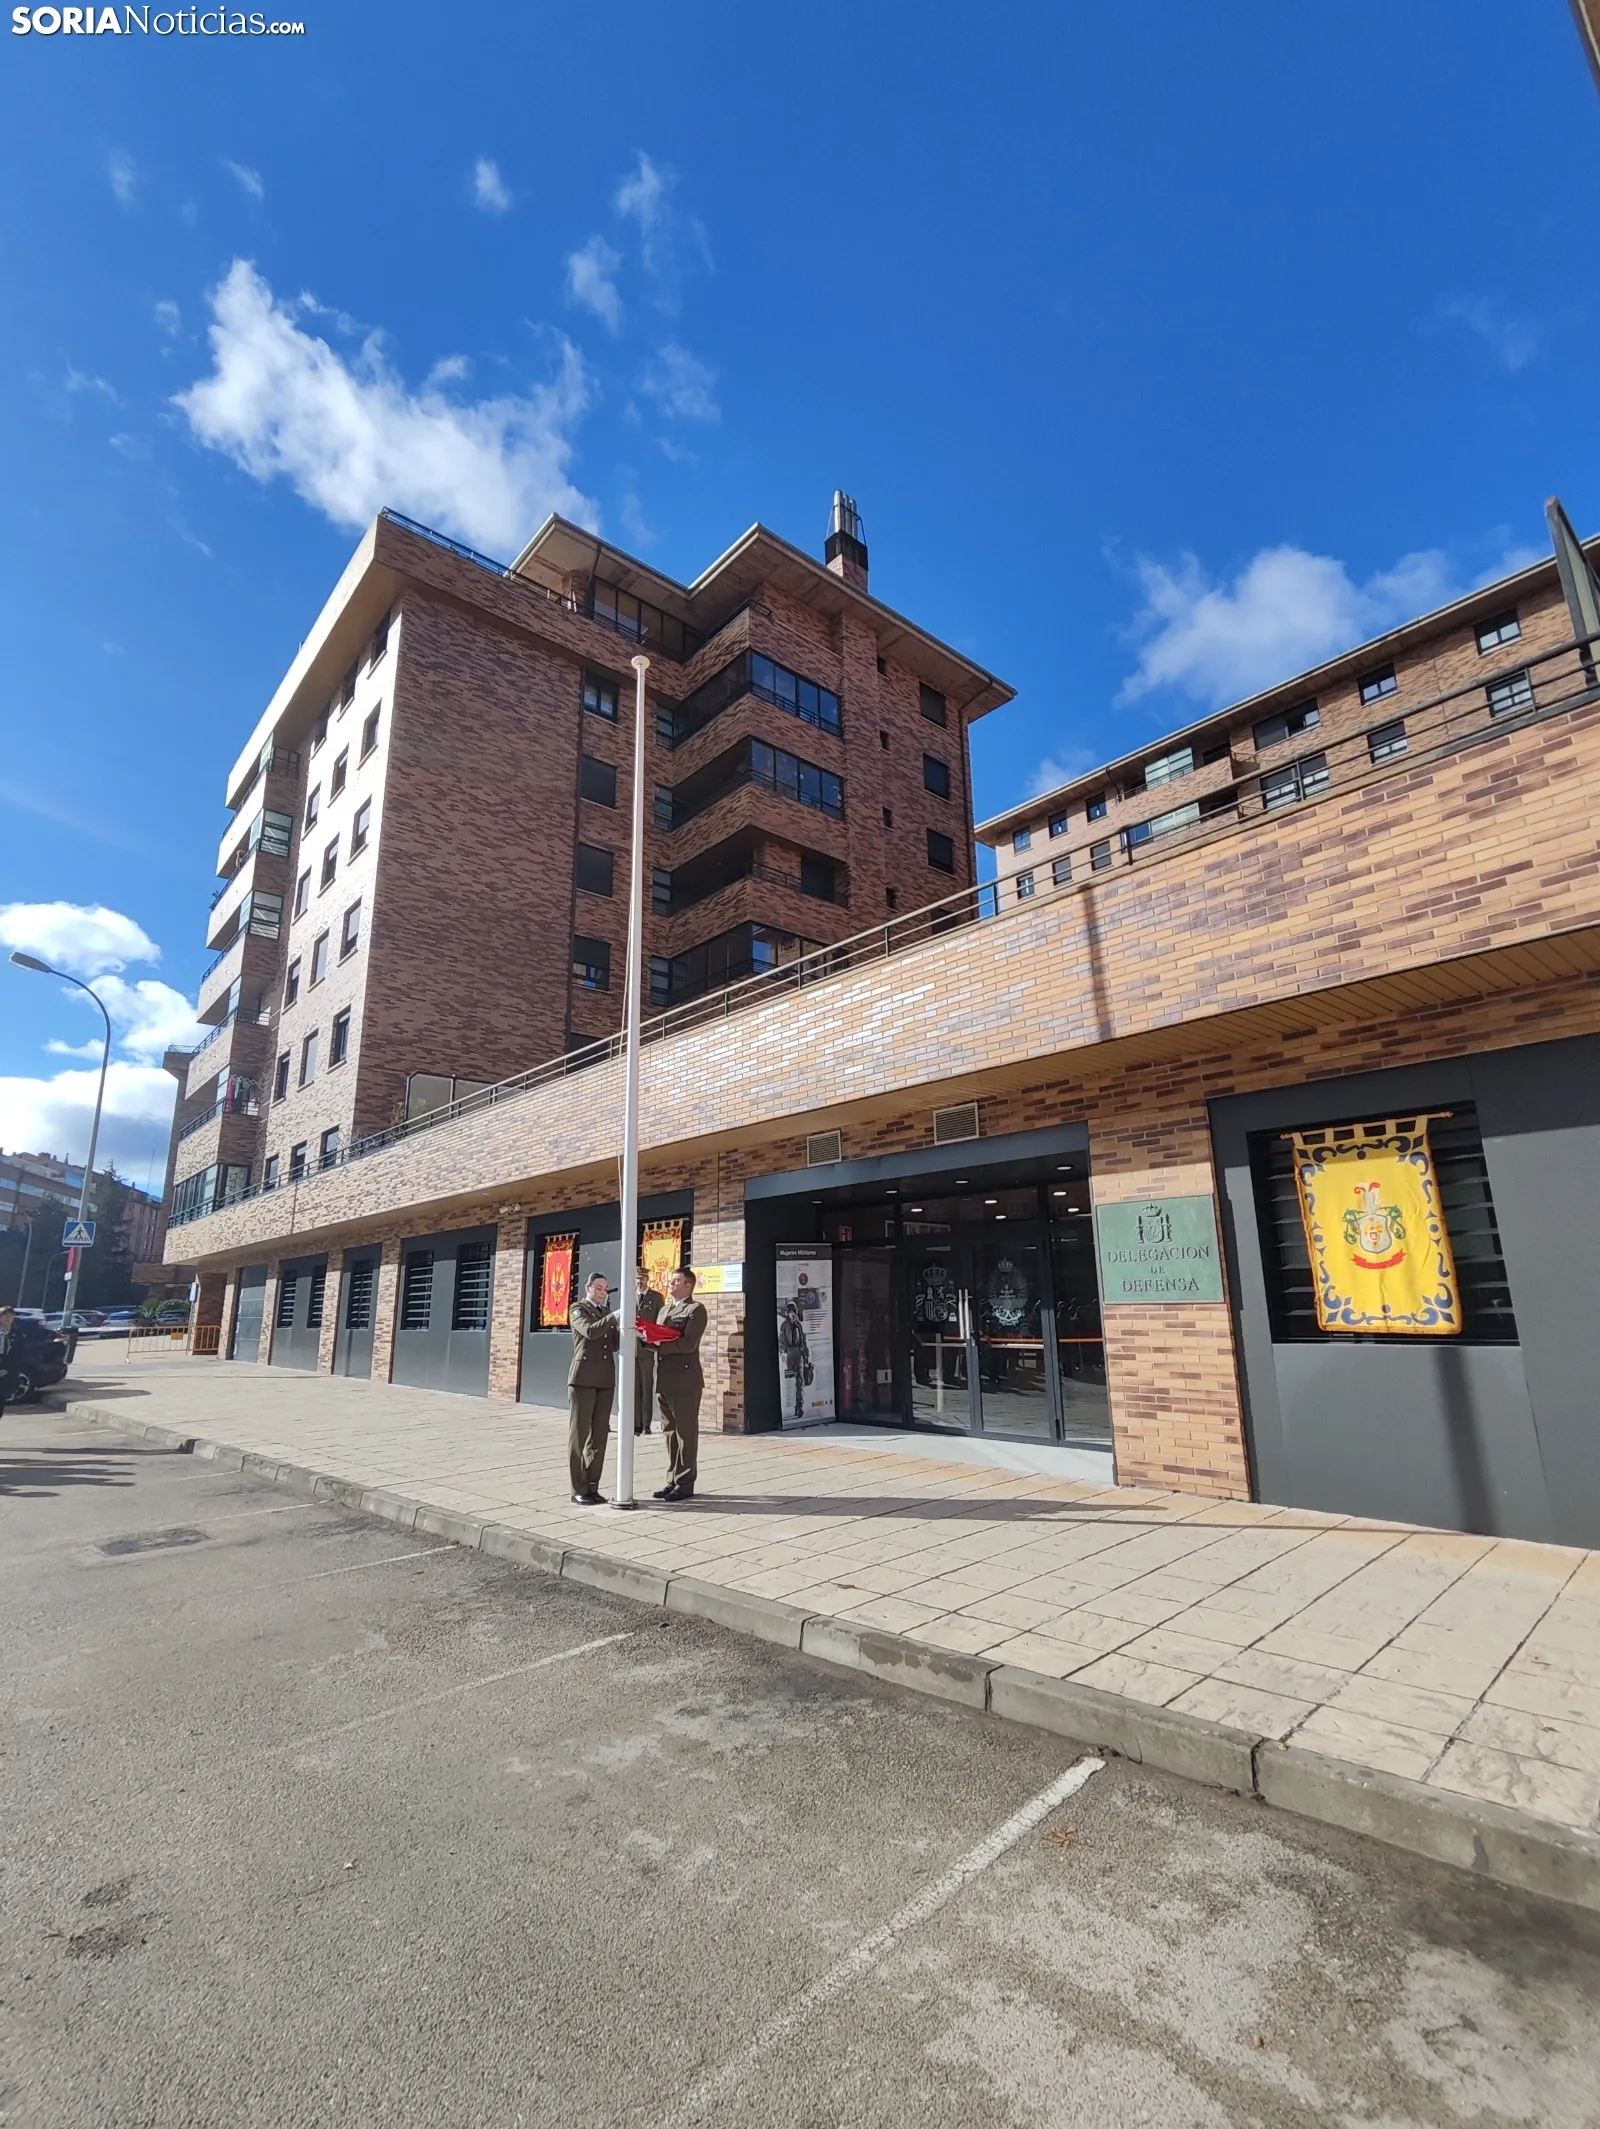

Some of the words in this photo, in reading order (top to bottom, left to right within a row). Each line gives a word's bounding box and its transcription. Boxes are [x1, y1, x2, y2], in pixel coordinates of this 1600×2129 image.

[1107, 1245, 1210, 1263] DELEGACION
[1150, 1265, 1166, 1275] DE
[1122, 1277, 1201, 1293] DEFENSA
